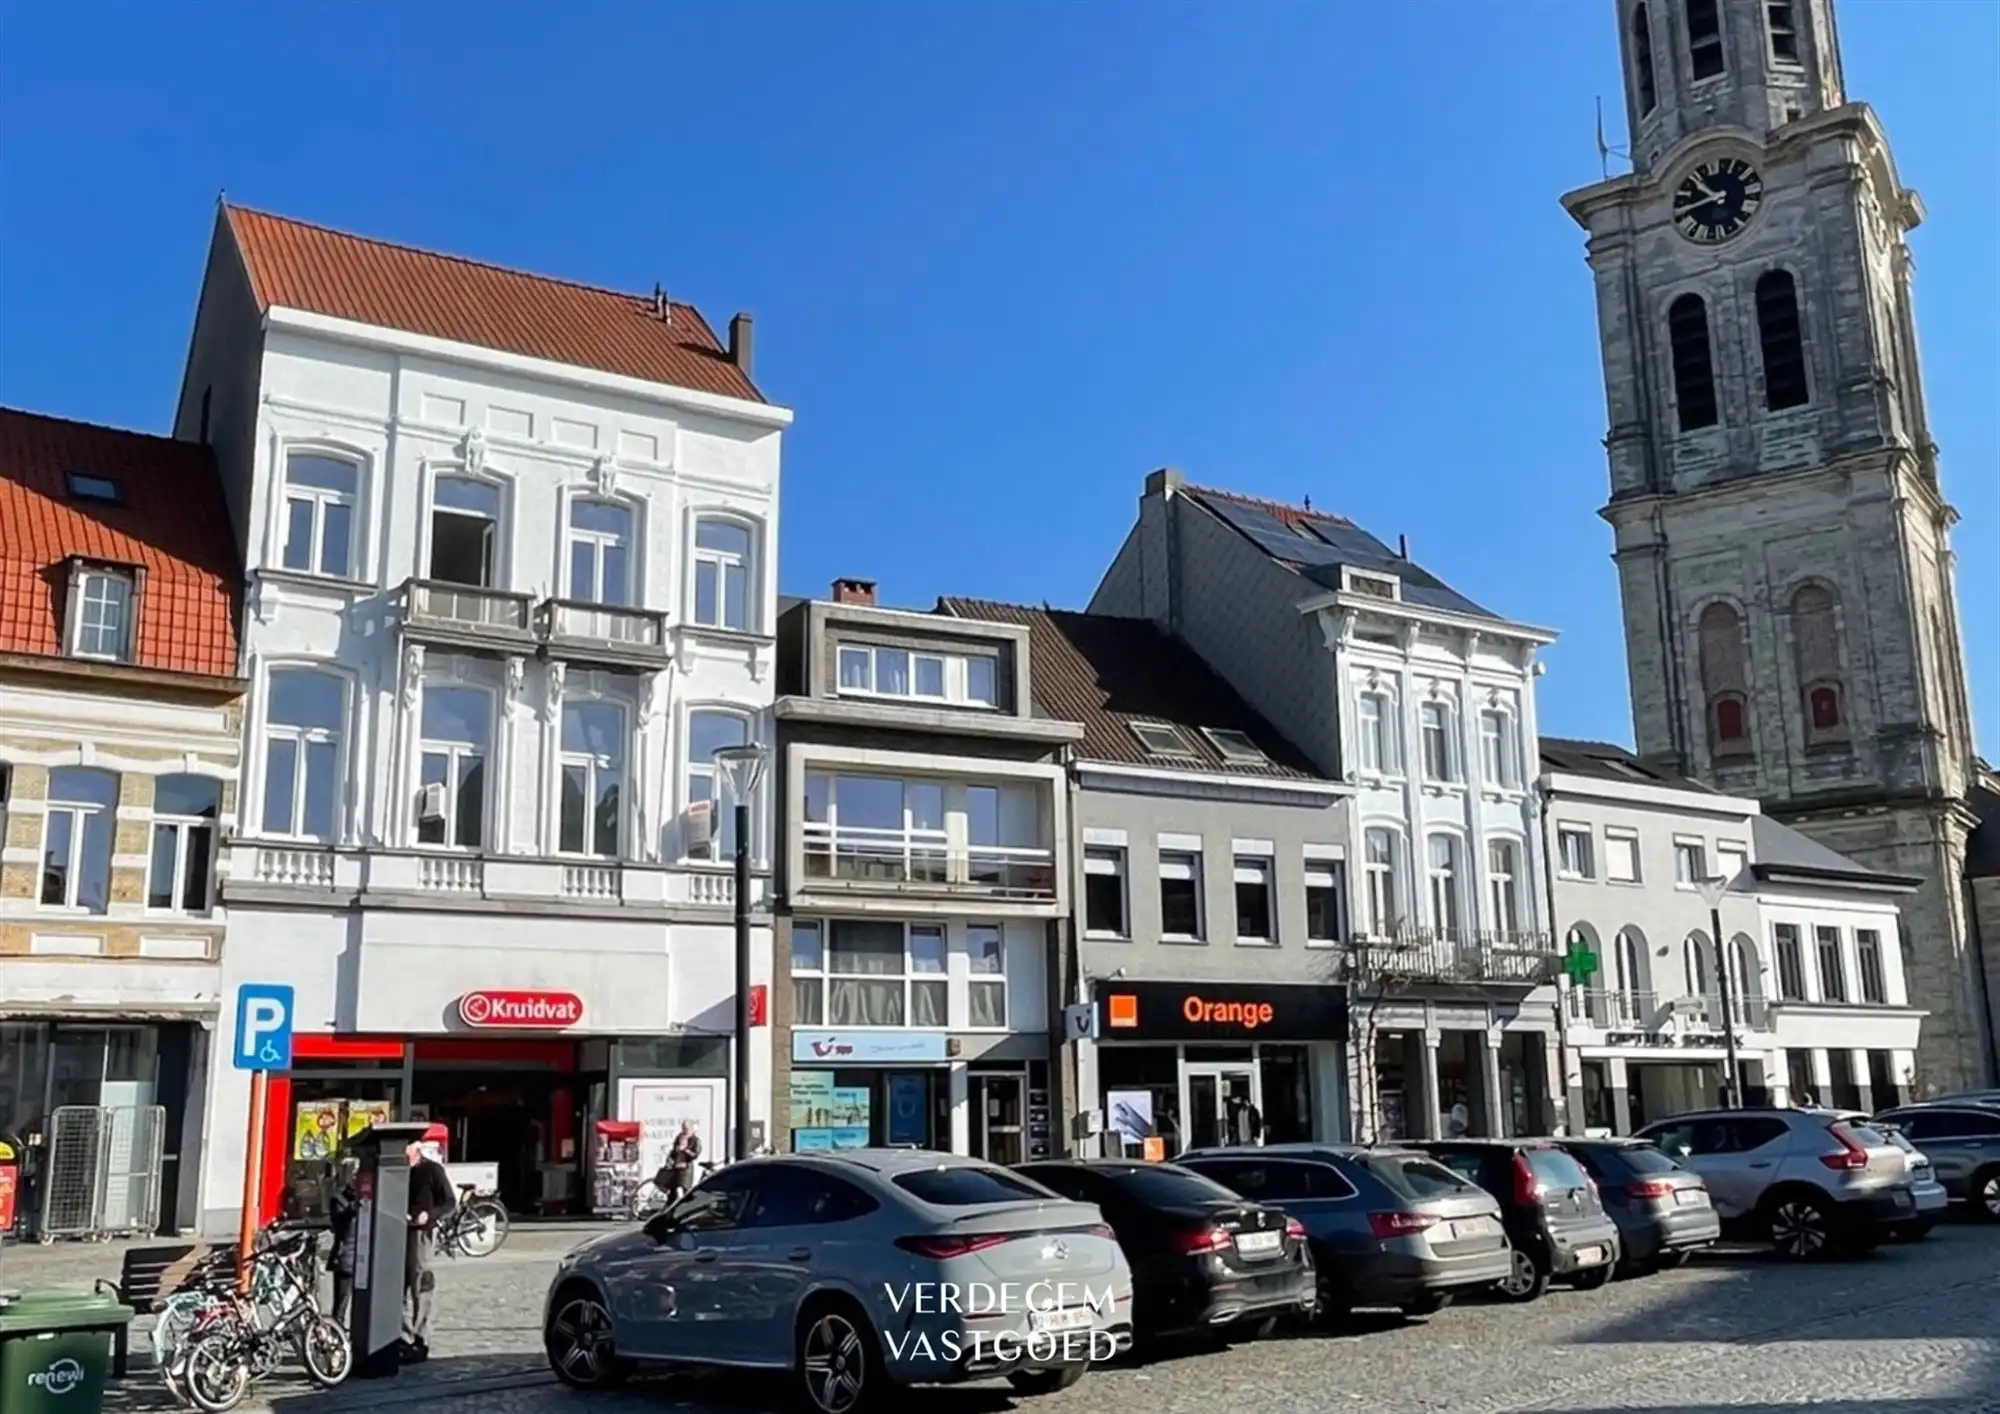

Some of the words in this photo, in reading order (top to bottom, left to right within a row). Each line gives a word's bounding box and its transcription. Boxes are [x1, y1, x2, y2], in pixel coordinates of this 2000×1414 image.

[491, 997, 577, 1020] Kruidvat
[1183, 995, 1274, 1029] Orange
[242, 997, 285, 1057] P
